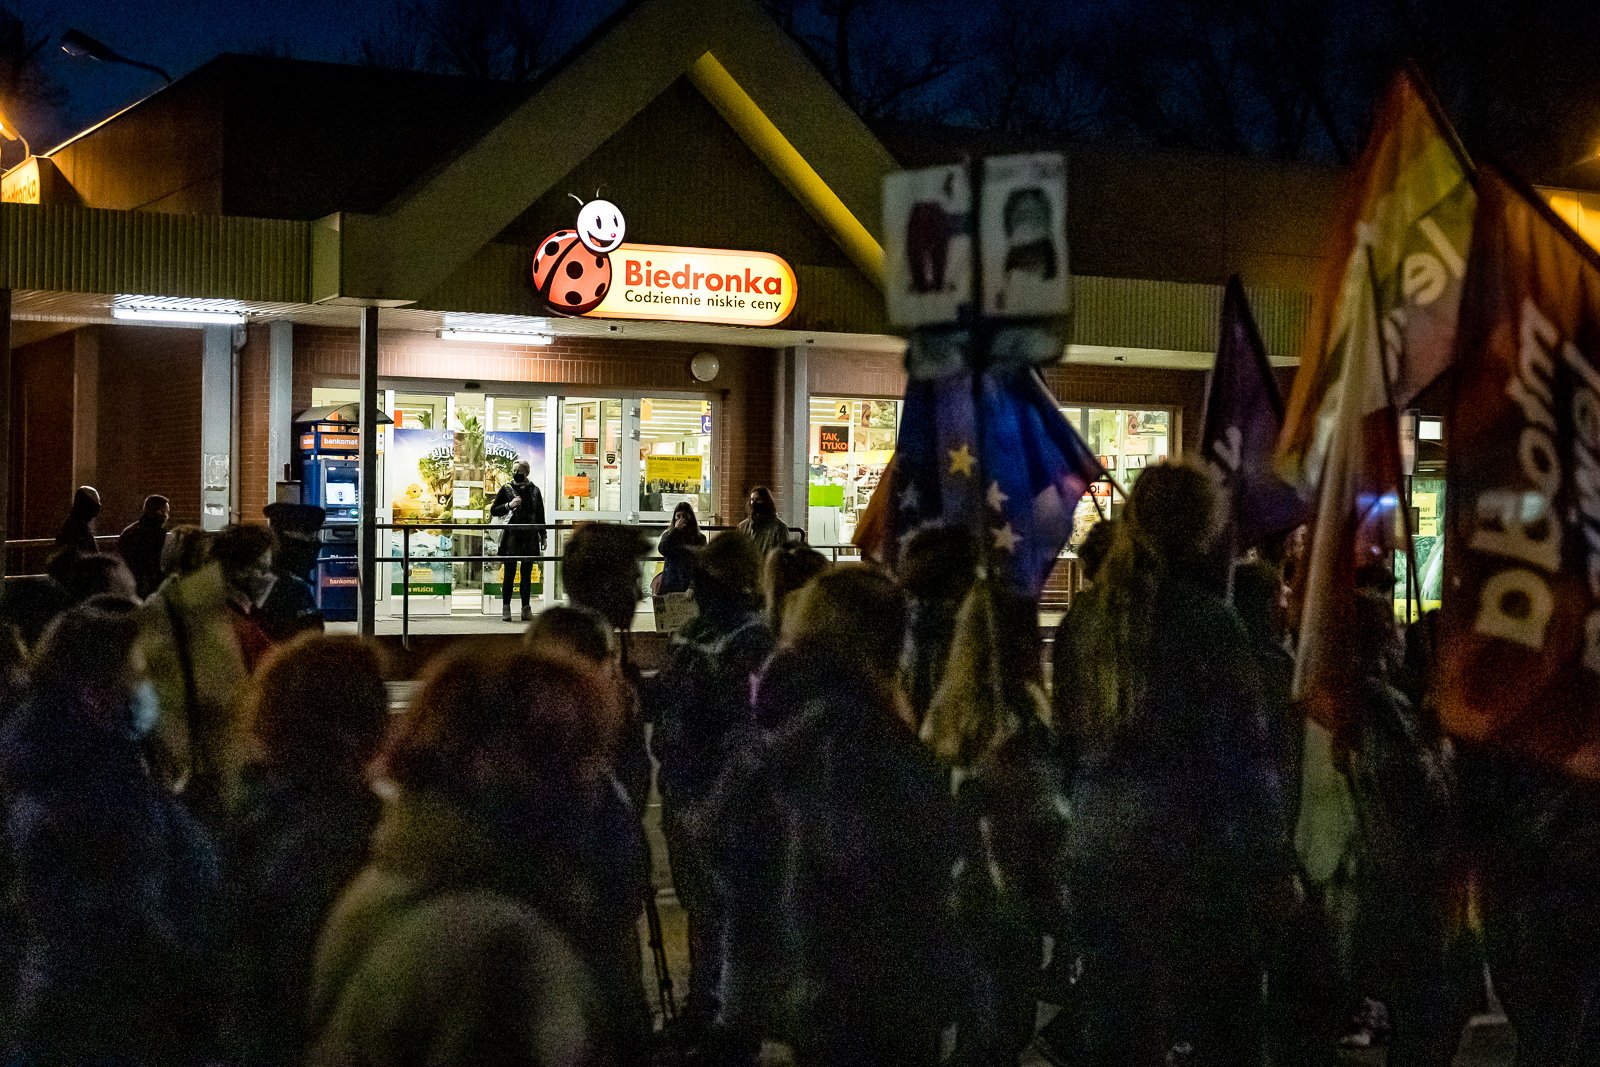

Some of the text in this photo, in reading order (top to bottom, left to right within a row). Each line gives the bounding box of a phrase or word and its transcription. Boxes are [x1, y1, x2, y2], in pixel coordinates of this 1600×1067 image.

[625, 260, 782, 295] Biedronka
[625, 290, 781, 312] Codziennie niskie ceny
[839, 404, 847, 415] 4
[324, 437, 358, 445] bankomat
[821, 432, 840, 442] TAK,
[821, 441, 847, 451] TYLKO
